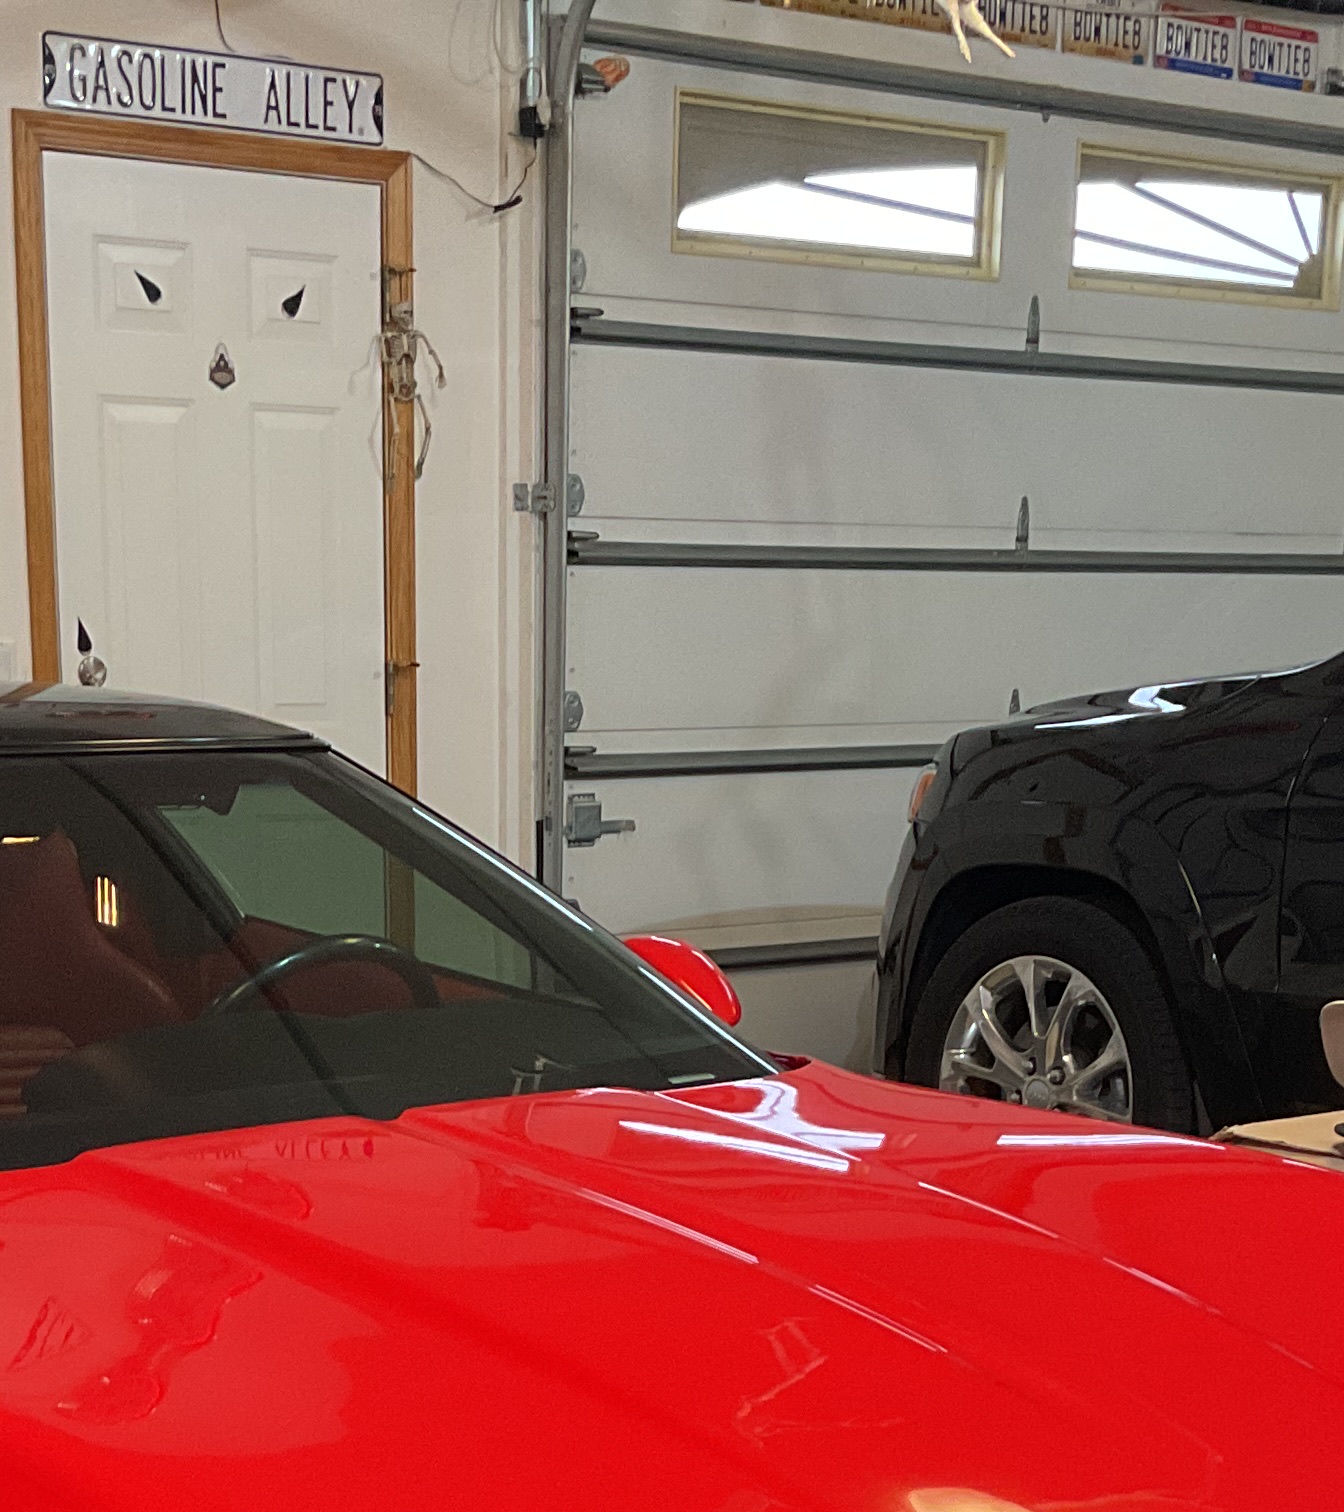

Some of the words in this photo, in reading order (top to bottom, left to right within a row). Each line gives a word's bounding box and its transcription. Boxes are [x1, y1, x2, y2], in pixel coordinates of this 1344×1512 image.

[1073, 9, 1142, 51] BOWTIE8
[1165, 21, 1229, 65] BOWTIE8
[1249, 36, 1311, 78] BOWTIE8
[68, 42, 227, 119] GASOLINE
[263, 69, 360, 134] ALLEY
